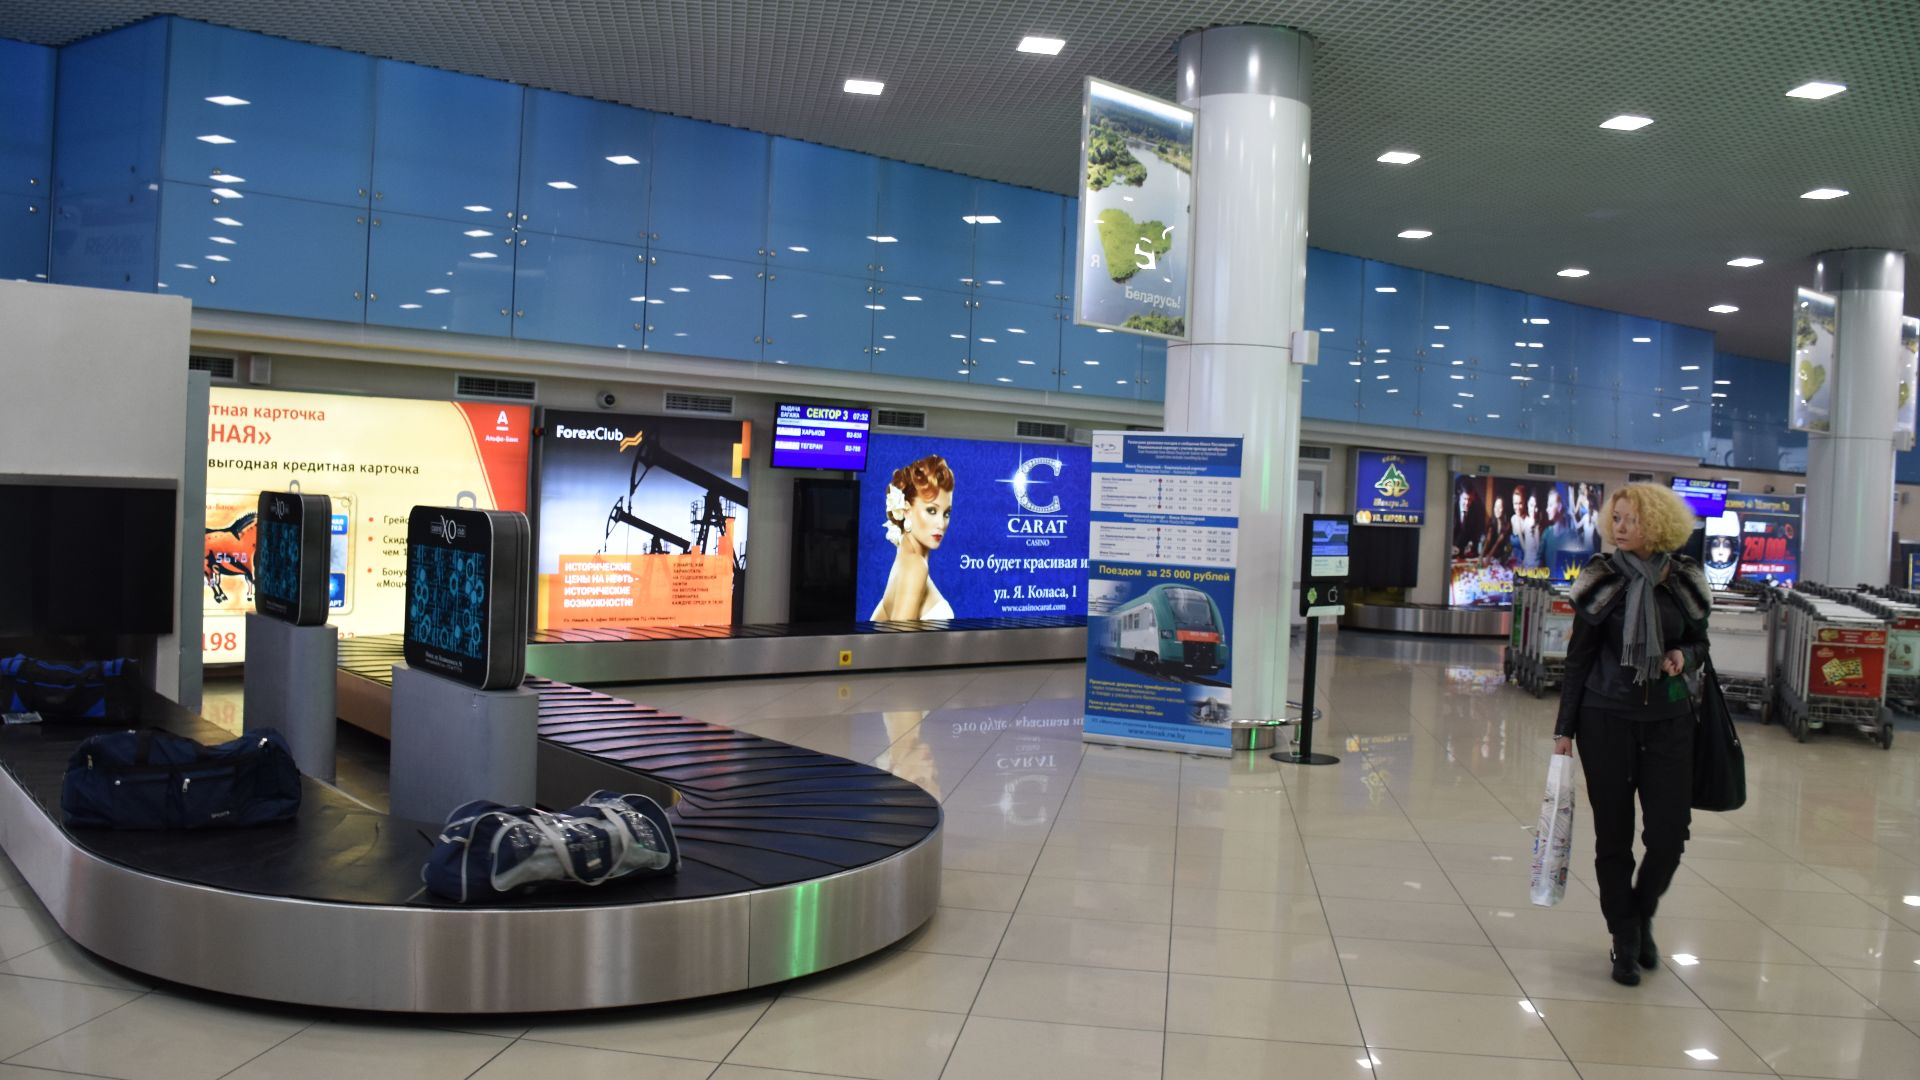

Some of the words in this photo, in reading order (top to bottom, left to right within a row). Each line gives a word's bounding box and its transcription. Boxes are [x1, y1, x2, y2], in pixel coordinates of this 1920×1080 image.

[253, 406, 326, 421] карточка
[807, 408, 842, 419] СЕКТОР
[843, 410, 849, 420] 3
[208, 423, 272, 445] НАЯ»
[556, 424, 624, 442] ForexClub
[800, 442, 824, 451] ТЕГЕРАН
[208, 458, 279, 471] выгодная
[283, 459, 356, 474] кредитная
[360, 463, 420, 476] карточка
[1007, 518, 1068, 534] CARAT
[383, 535, 408, 545] Скид
[1026, 538, 1050, 547] CASINO
[216, 552, 248, 564] 5678
[564, 562, 633, 572] ИСТОРИЧЕСКИЕ
[959, 554, 985, 570] Это
[986, 554, 1021, 575] будет
[1023, 558, 1078, 574] красивая
[564, 574, 591, 585] ЦЕНЫ
[592, 574, 605, 584] НА
[606, 574, 634, 584] НЕФТЬ
[1099, 565, 1142, 577] Поездом
[1147, 569, 1158, 577] за
[1160, 568, 1172, 578] 25
[1173, 569, 1191, 579] 000
[1193, 571, 1231, 582] рублей
[563, 586, 631, 597] ИСТОРИЧЕСКИЕ
[993, 586, 1011, 604] ул.
[1013, 585, 1025, 599] Я.
[1028, 585, 1069, 600] Коласа,
[1071, 585, 1077, 598] 1
[563, 599, 634, 609] ВОЗМОЖНОСТИ!
[1001, 603, 1067, 612] www.casinocarat.com
